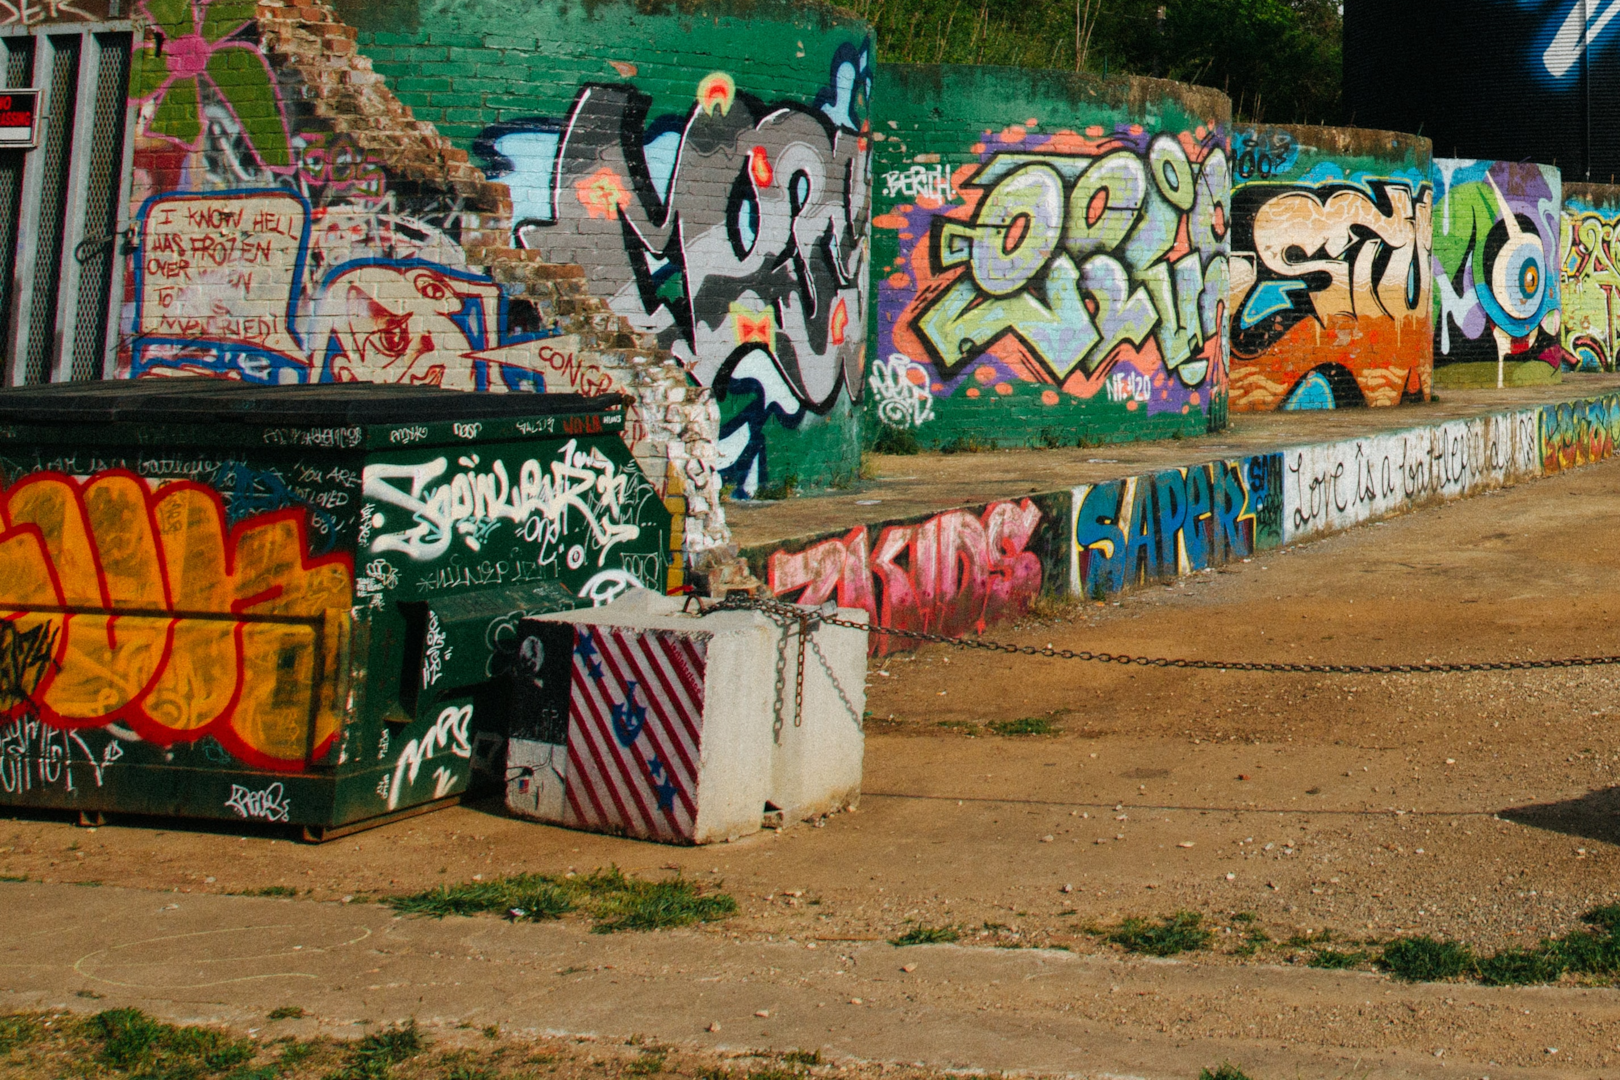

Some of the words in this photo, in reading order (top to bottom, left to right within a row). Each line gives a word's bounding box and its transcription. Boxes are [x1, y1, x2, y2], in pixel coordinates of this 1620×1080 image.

[159, 209, 177, 225] I
[253, 210, 299, 241] HELL
[152, 234, 186, 257] HAS
[190, 233, 272, 266] FROZEN
[147, 258, 191, 281] OVER
[1289, 452, 1347, 529] Love
[1353, 442, 1377, 506] is
[1382, 455, 1395, 498] a
